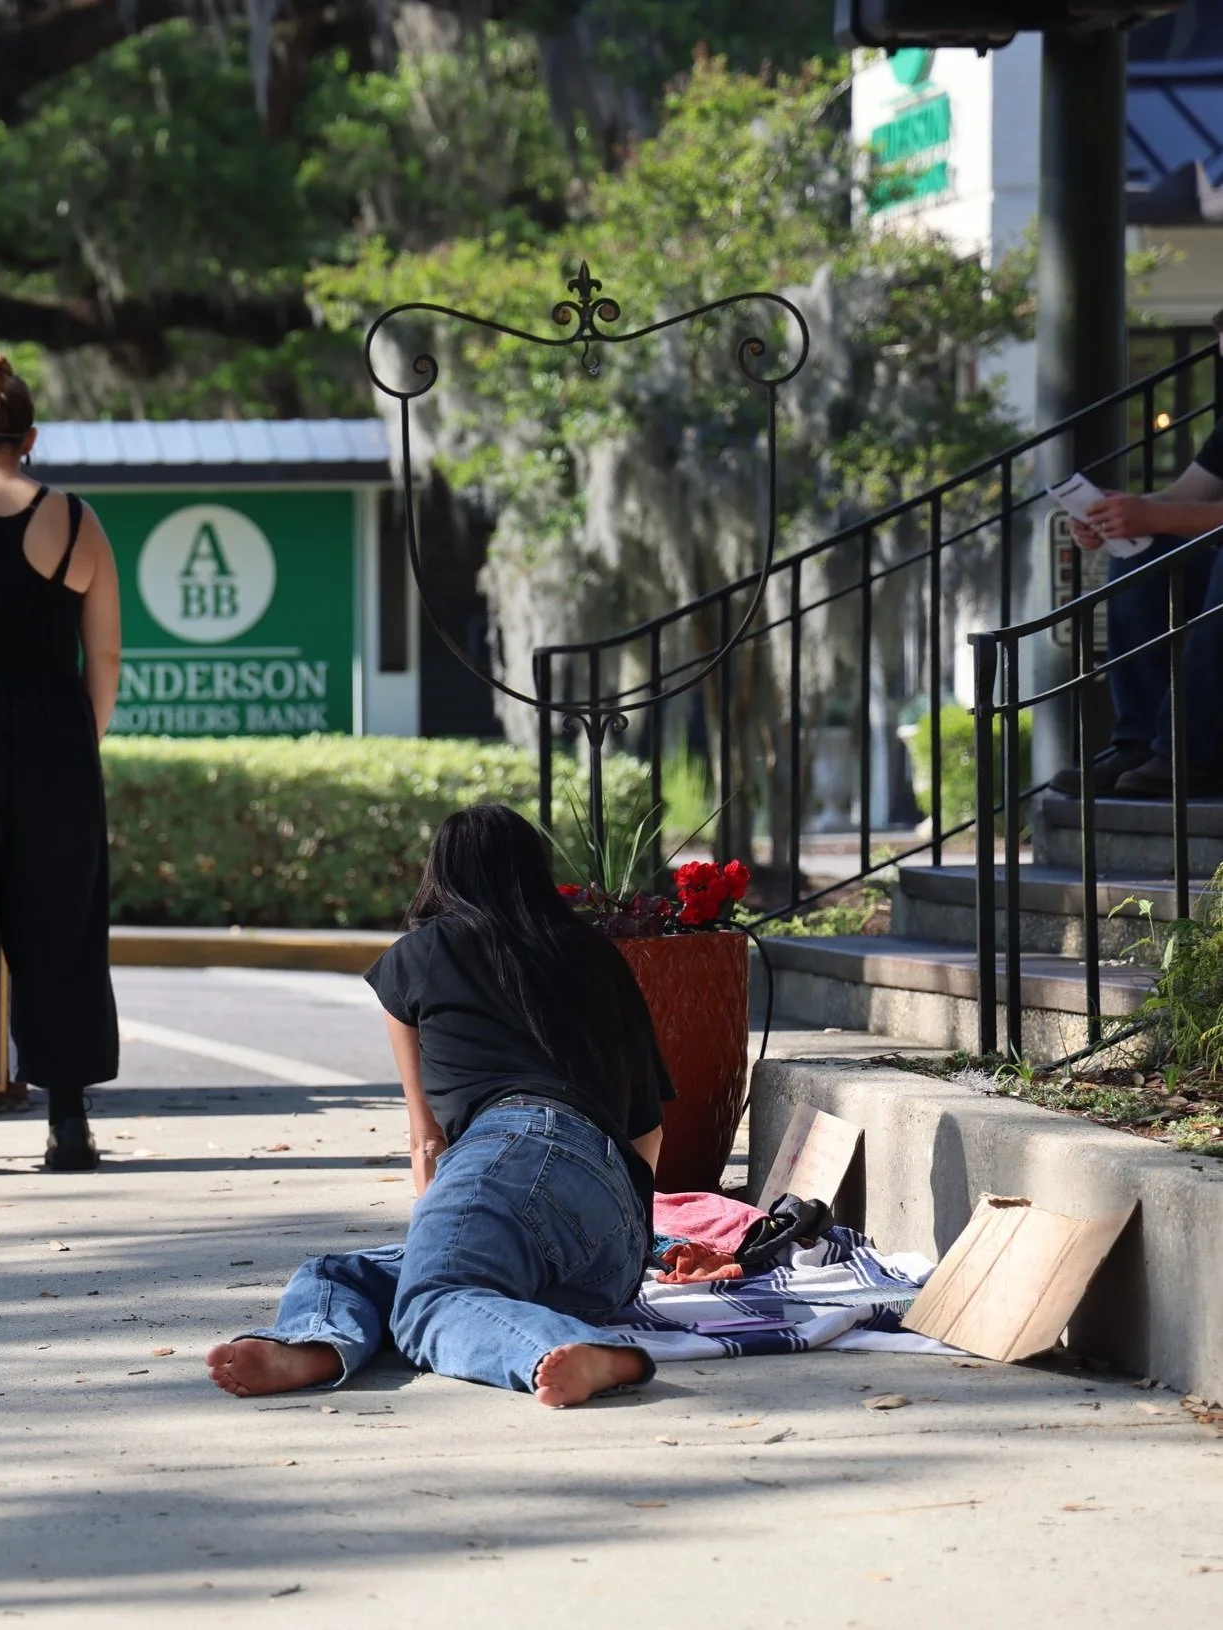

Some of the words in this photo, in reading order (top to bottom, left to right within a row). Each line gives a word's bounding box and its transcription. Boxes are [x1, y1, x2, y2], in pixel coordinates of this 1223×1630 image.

[180, 520, 234, 578] A
[180, 583, 239, 619] BB
[118, 661, 328, 700] NDERSON
[109, 703, 240, 732] ROTHERS
[245, 703, 328, 733] BANK
